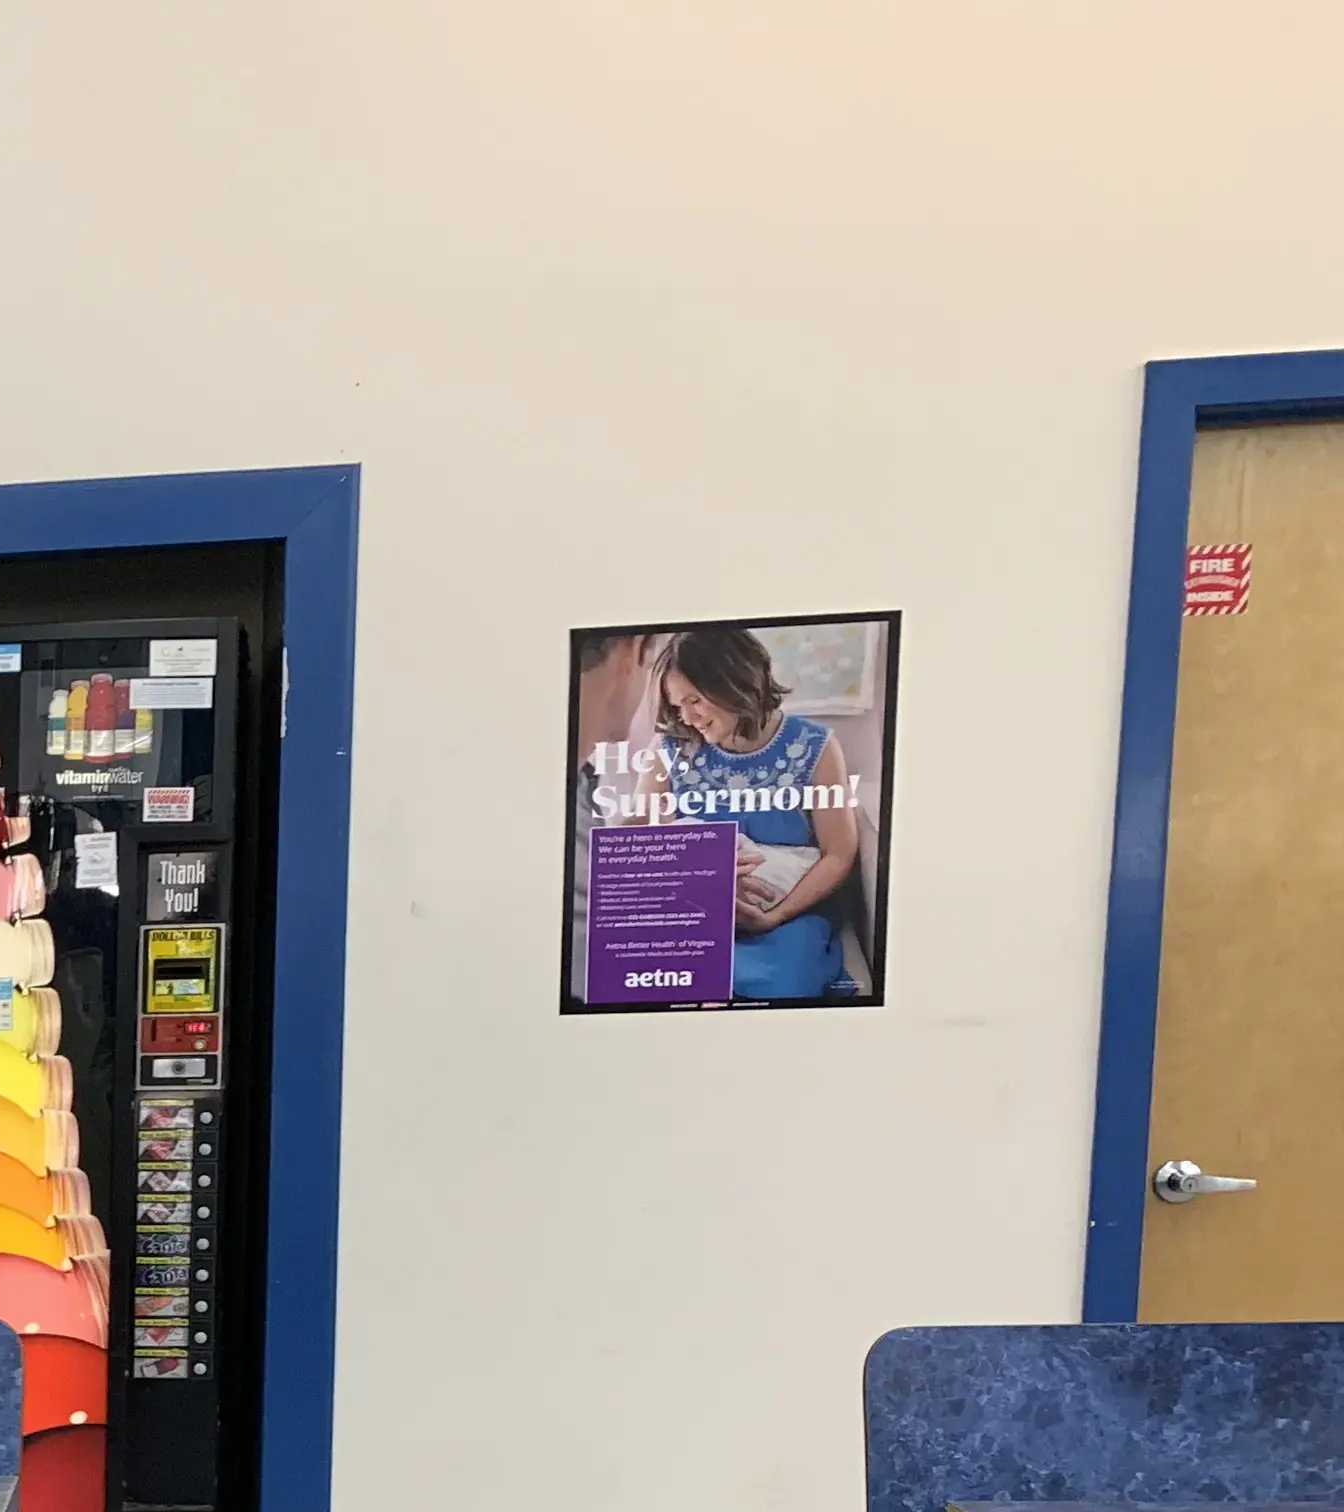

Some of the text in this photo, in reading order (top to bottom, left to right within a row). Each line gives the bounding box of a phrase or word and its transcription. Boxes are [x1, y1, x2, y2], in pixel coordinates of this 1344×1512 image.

[1190, 558, 1235, 574] FIRE
[593, 740, 690, 782] Hey,
[591, 774, 861, 826] Supermom!
[633, 833, 653, 842] hero
[664, 831, 702, 842] everyday
[632, 844, 643, 852] be
[644, 844, 664, 855] your
[666, 843, 686, 851] hero
[608, 855, 647, 865] everyday
[160, 859, 206, 885] Thank
[164, 887, 200, 913] You!
[624, 968, 694, 988] aetna
